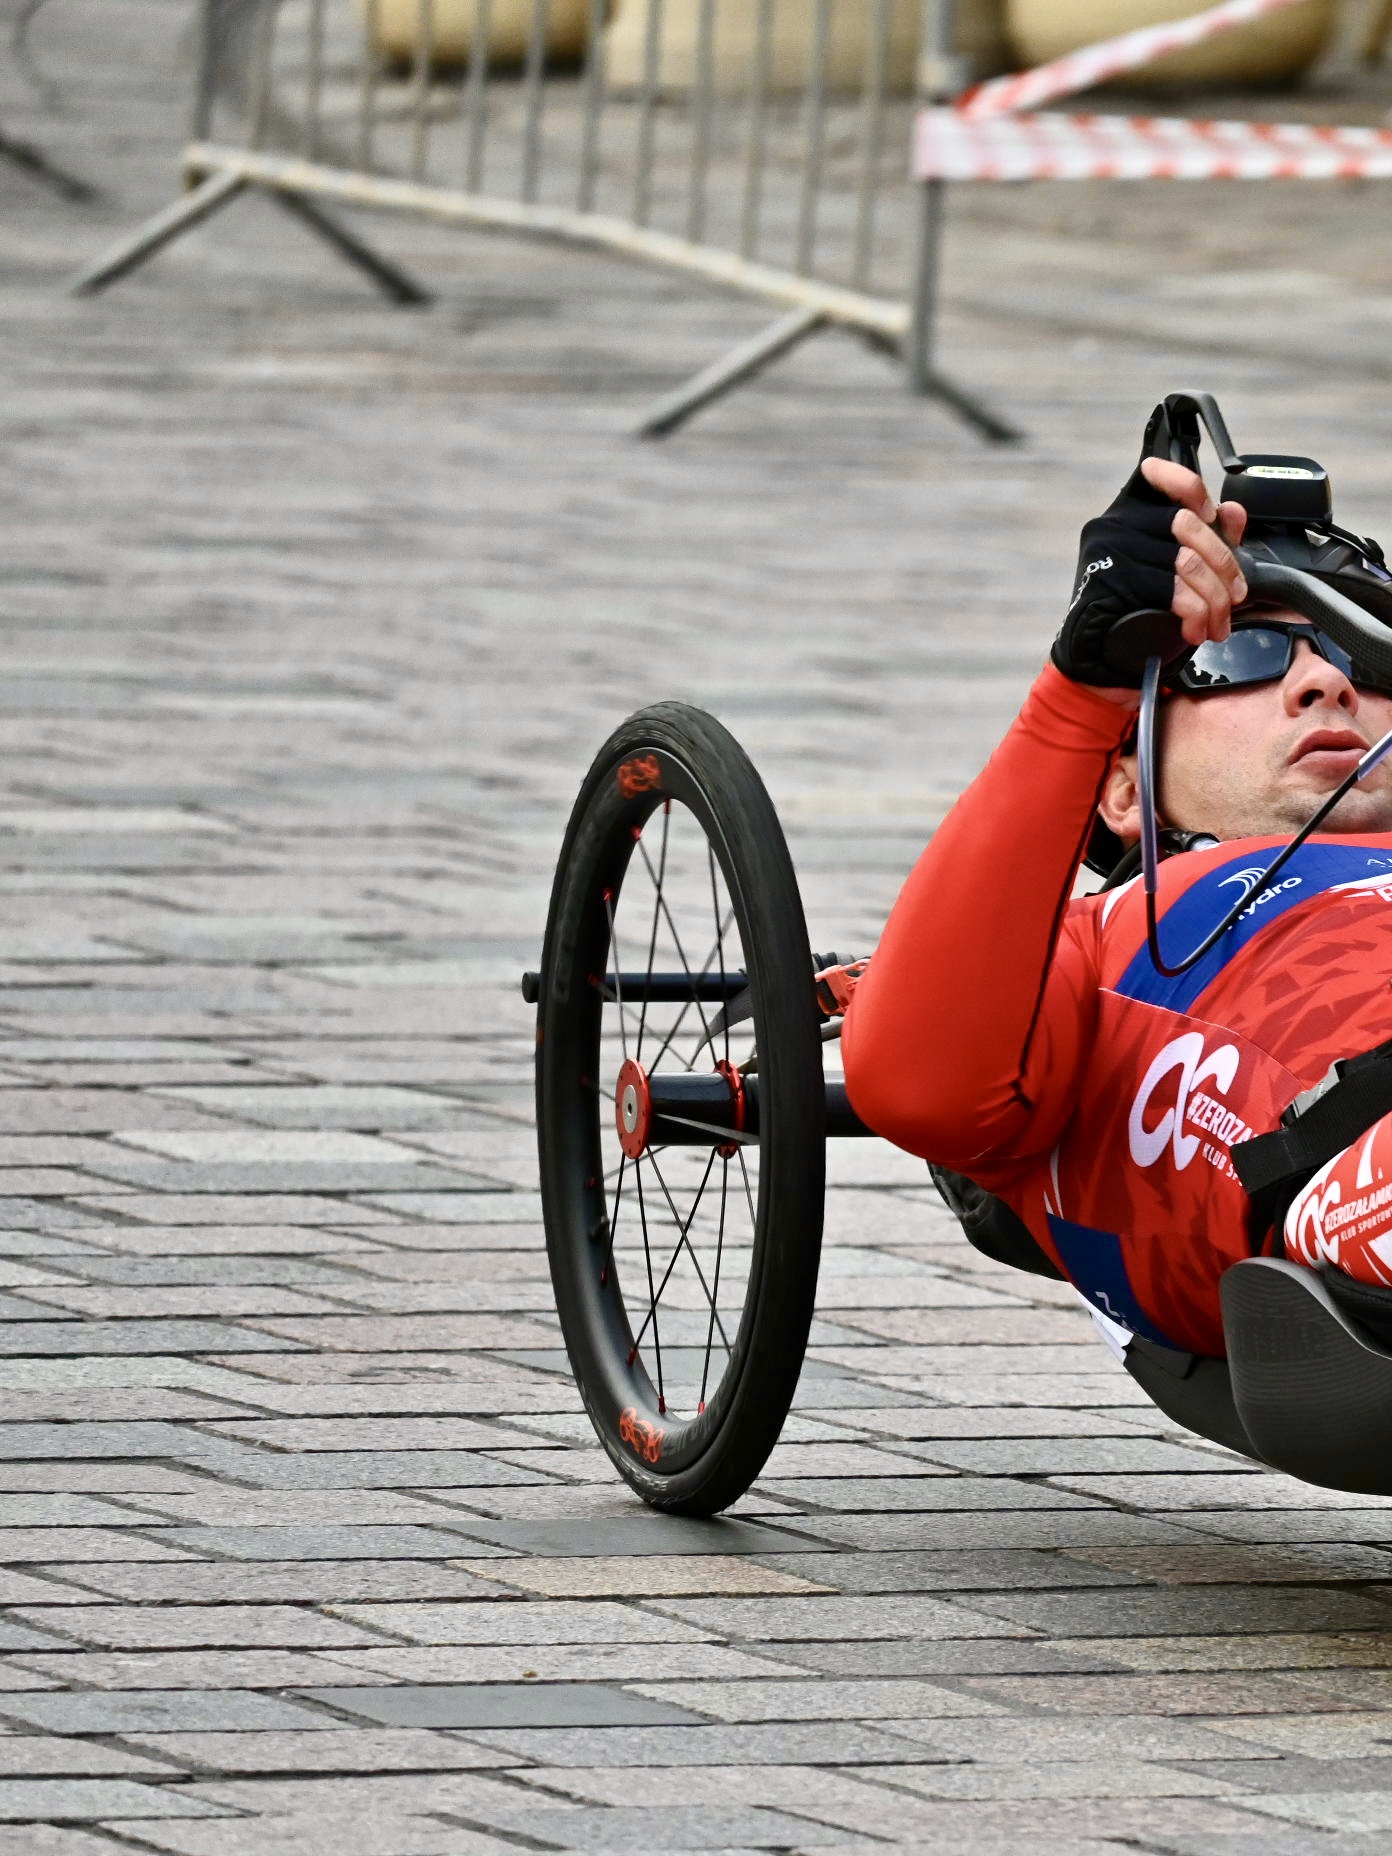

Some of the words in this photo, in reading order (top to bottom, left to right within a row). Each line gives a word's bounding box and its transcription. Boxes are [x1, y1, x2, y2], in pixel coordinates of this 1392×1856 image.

[1227, 876, 1303, 931] ydro
[1186, 1091, 1259, 1147] #ZEROZA
[1202, 1142, 1228, 1171] KLUB
